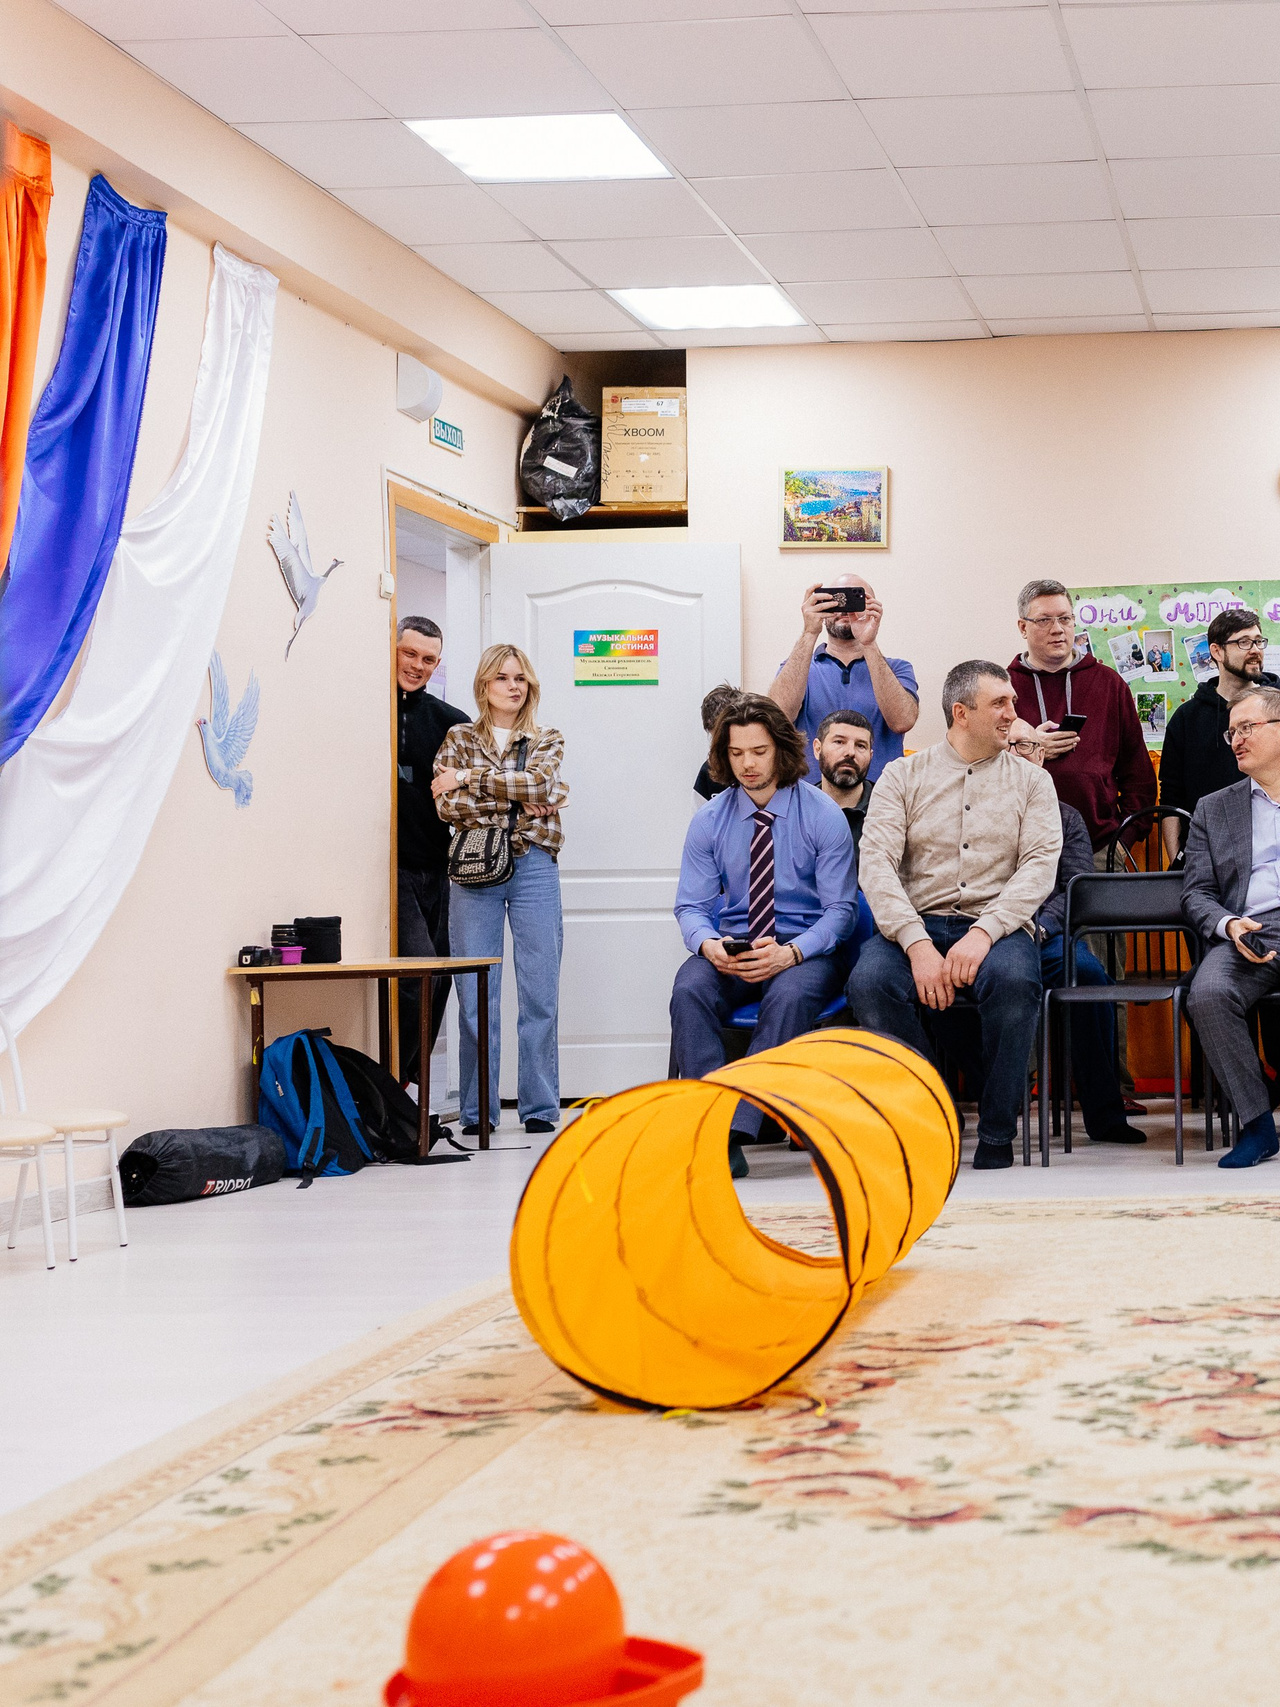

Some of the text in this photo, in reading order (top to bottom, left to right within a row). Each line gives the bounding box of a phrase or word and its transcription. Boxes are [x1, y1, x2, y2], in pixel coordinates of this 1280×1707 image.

[434, 419, 463, 449] ВЫХОД
[623, 427, 665, 437] XBOOM
[589, 634, 654, 642] МУЗЫКАЛЬНАЯ
